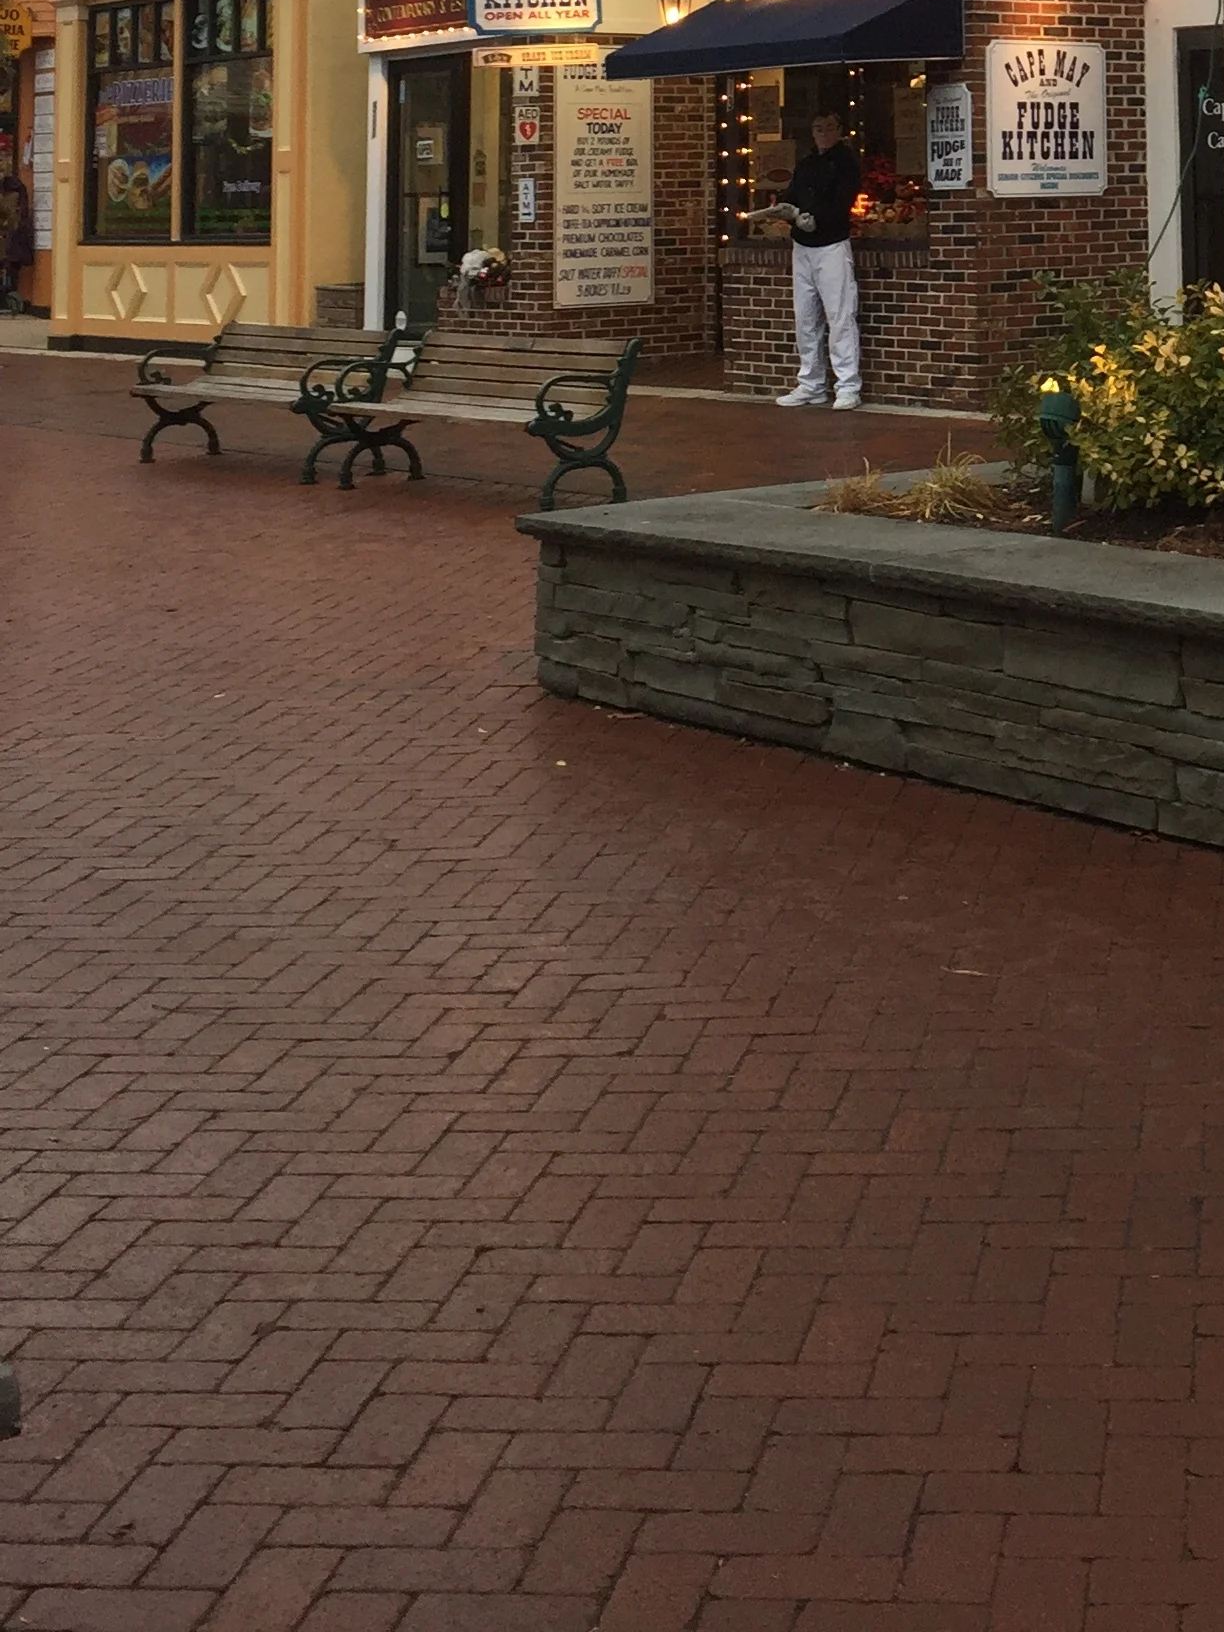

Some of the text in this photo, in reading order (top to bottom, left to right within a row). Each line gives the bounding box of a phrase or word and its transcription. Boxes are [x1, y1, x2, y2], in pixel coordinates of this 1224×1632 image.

[484, 9, 590, 21] OPEN ALL YEAR
[0, 24, 25, 36] RIA
[1004, 48, 1091, 88] CAPE MAY
[1039, 78, 1058, 87] AND
[577, 107, 631, 121] SPECIAL
[1017, 101, 1080, 130] FUDGE
[586, 122, 623, 134] TODAY
[930, 140, 966, 162] FUDGE
[1001, 131, 1095, 160] KITCHEN
[934, 168, 963, 181] MADE
